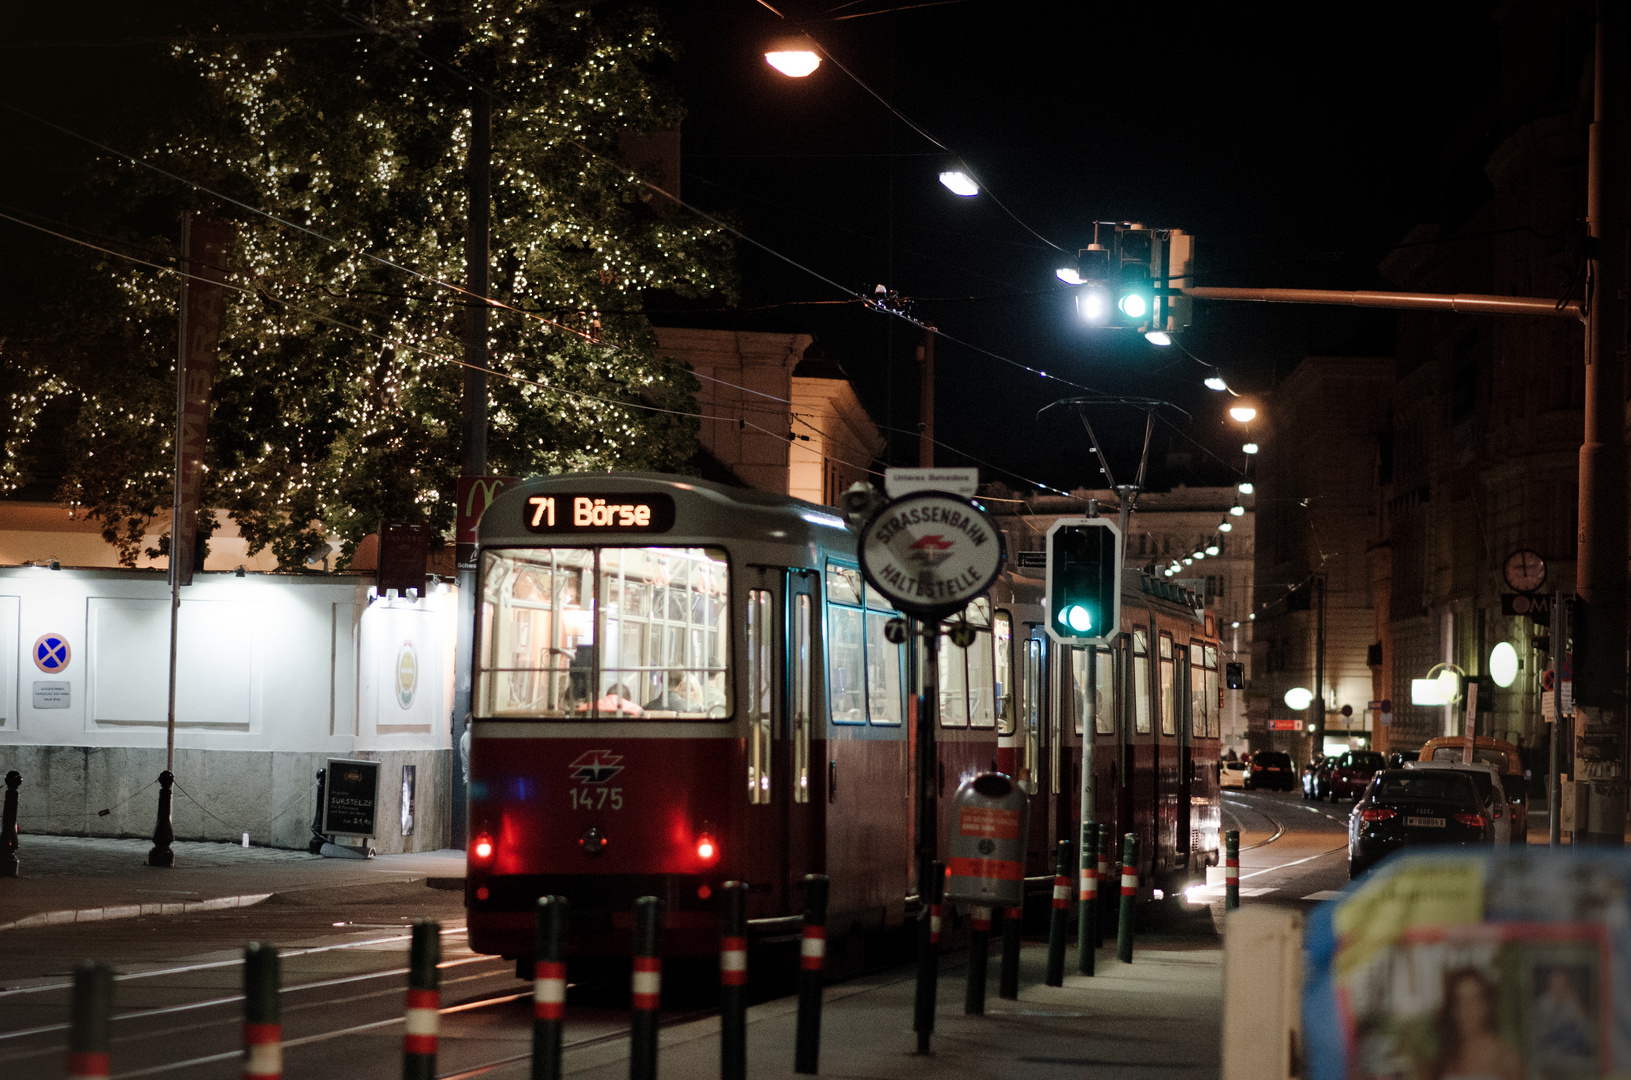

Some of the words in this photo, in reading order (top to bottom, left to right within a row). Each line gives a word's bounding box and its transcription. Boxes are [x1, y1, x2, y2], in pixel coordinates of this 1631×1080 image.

[529, 497, 555, 527] 71
[574, 497, 651, 527] Börse
[876, 506, 988, 547] STRASSENBAHN
[569, 787, 623, 811] 1475
